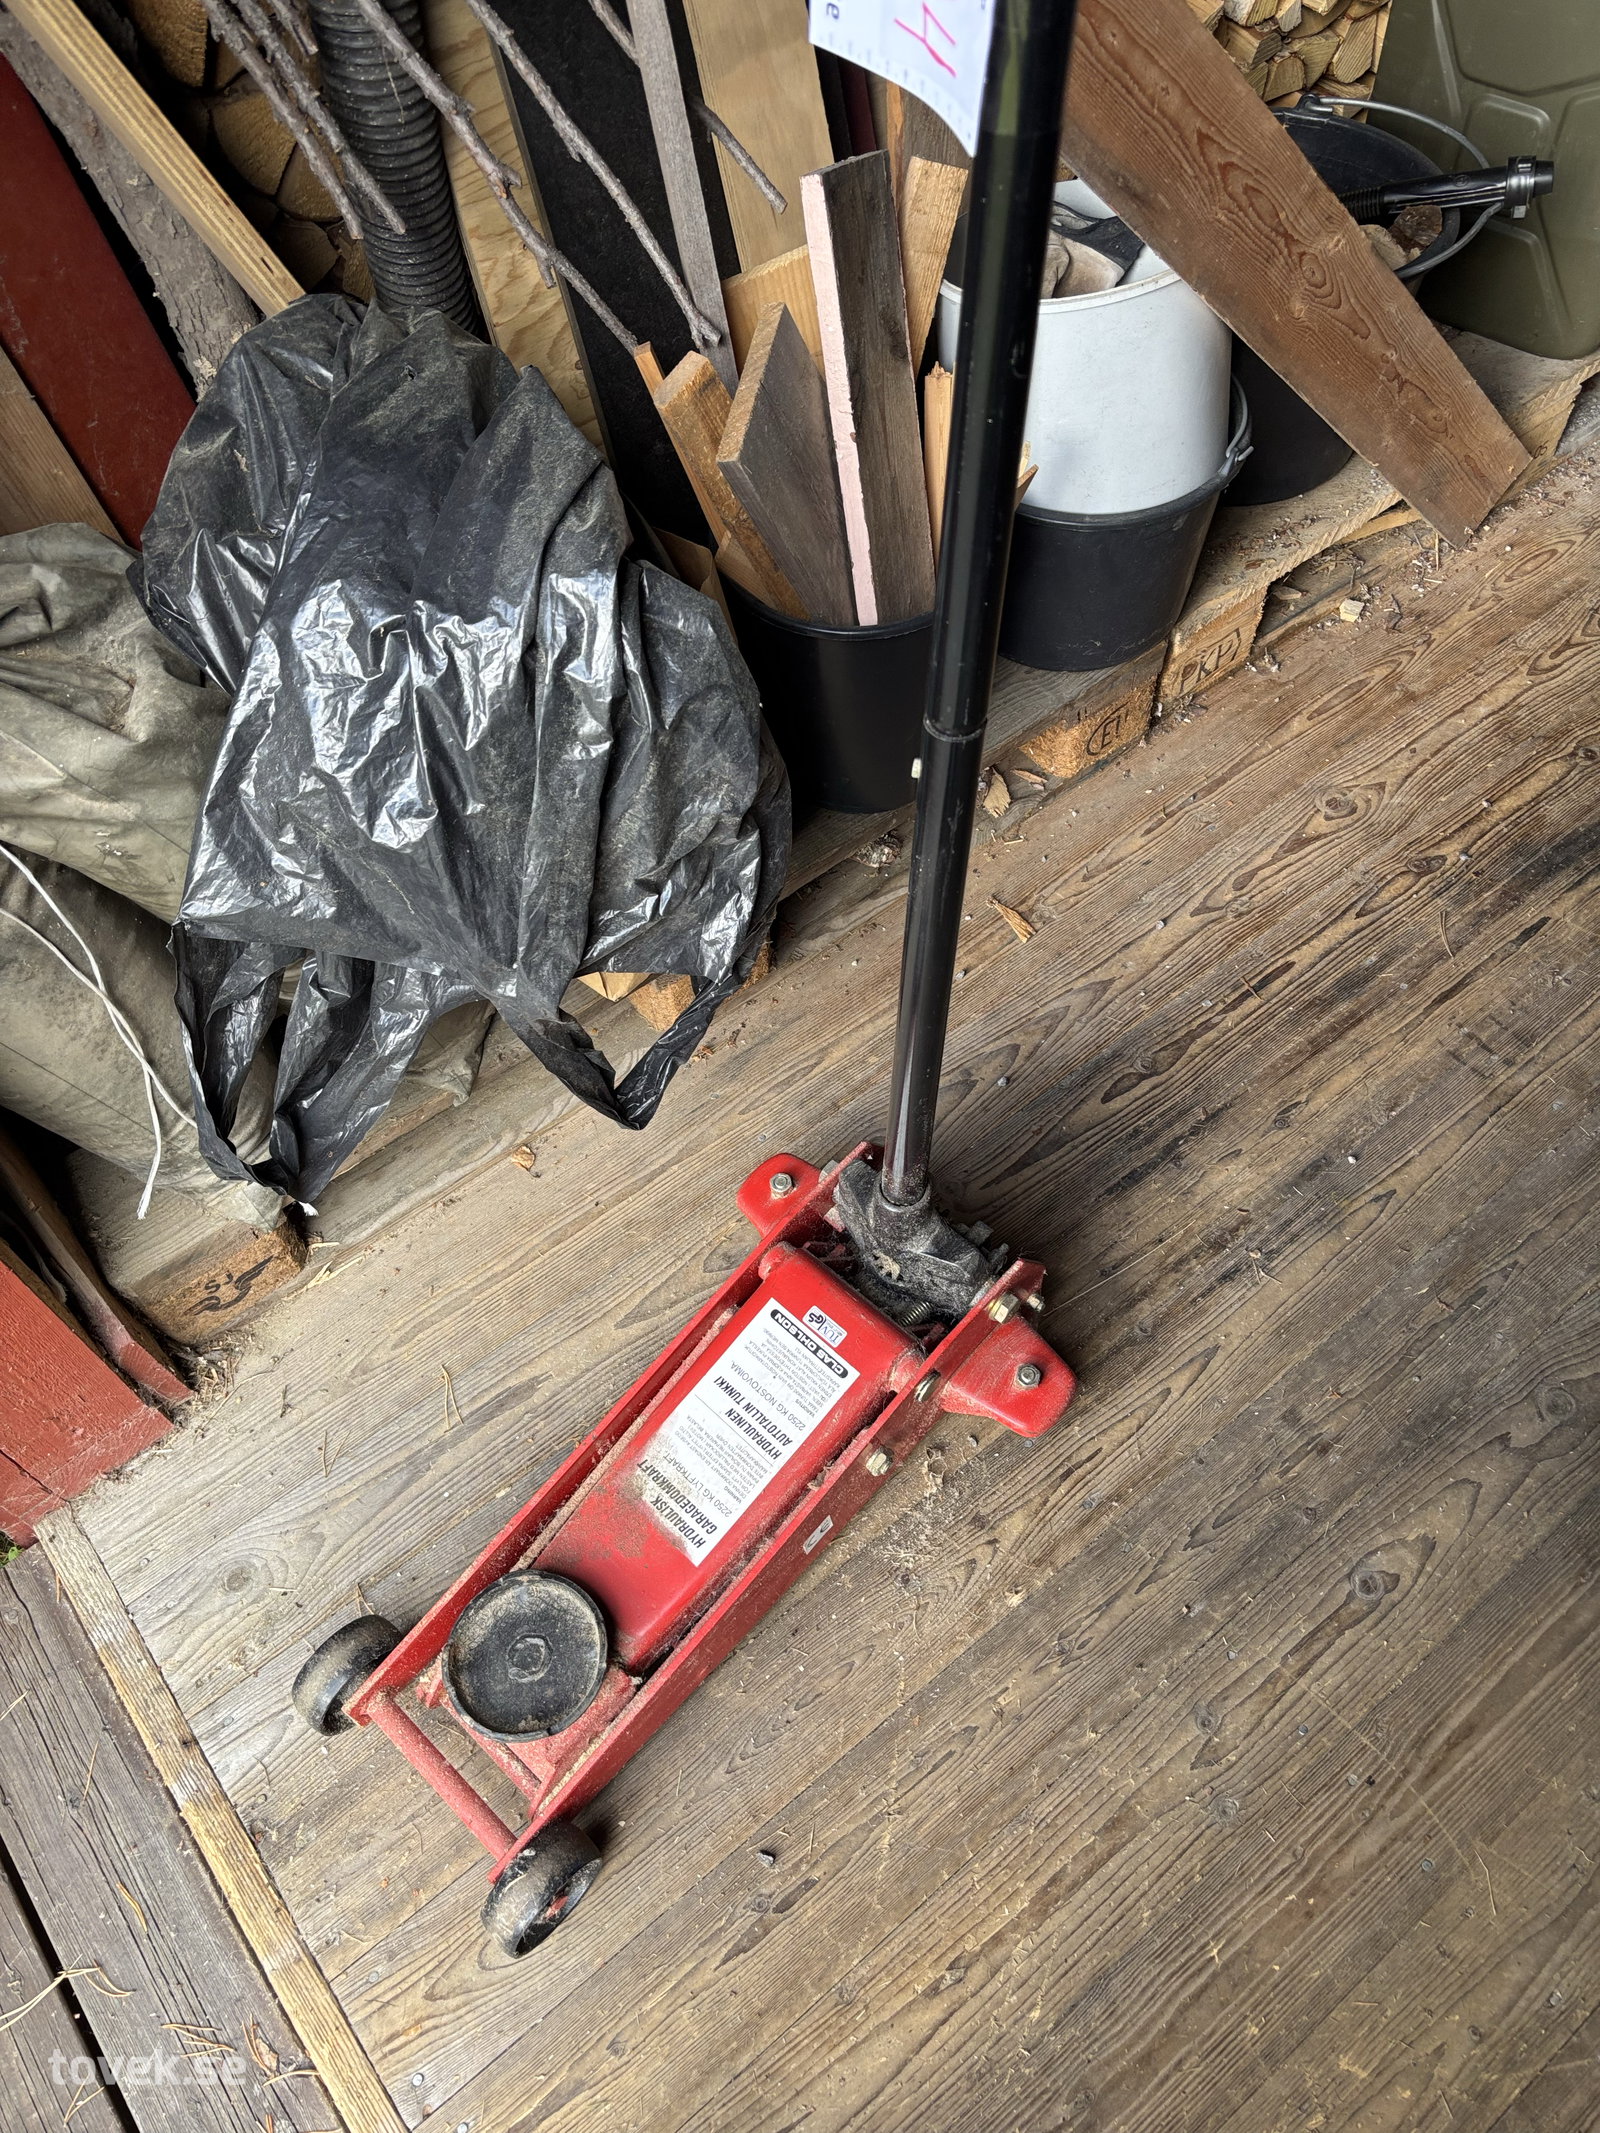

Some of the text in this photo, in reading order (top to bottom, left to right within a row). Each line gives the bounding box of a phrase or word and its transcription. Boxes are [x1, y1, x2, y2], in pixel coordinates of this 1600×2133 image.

[773, 1311, 818, 1352] OHLSON
[815, 1347, 845, 1375] CLAS
[713, 1375, 793, 1447] AUTOTALLIN TUNKKI
[775, 1402, 789, 1416] KG
[786, 1412, 806, 1431] 2250
[724, 1407, 782, 1460] HYDRAULINEN
[636, 1458, 718, 1535] GARAGEDOMKRAFT
[701, 1487, 715, 1502] KG
[712, 1498, 733, 1518] 2250
[649, 1495, 706, 1548] HYDRAULISK
